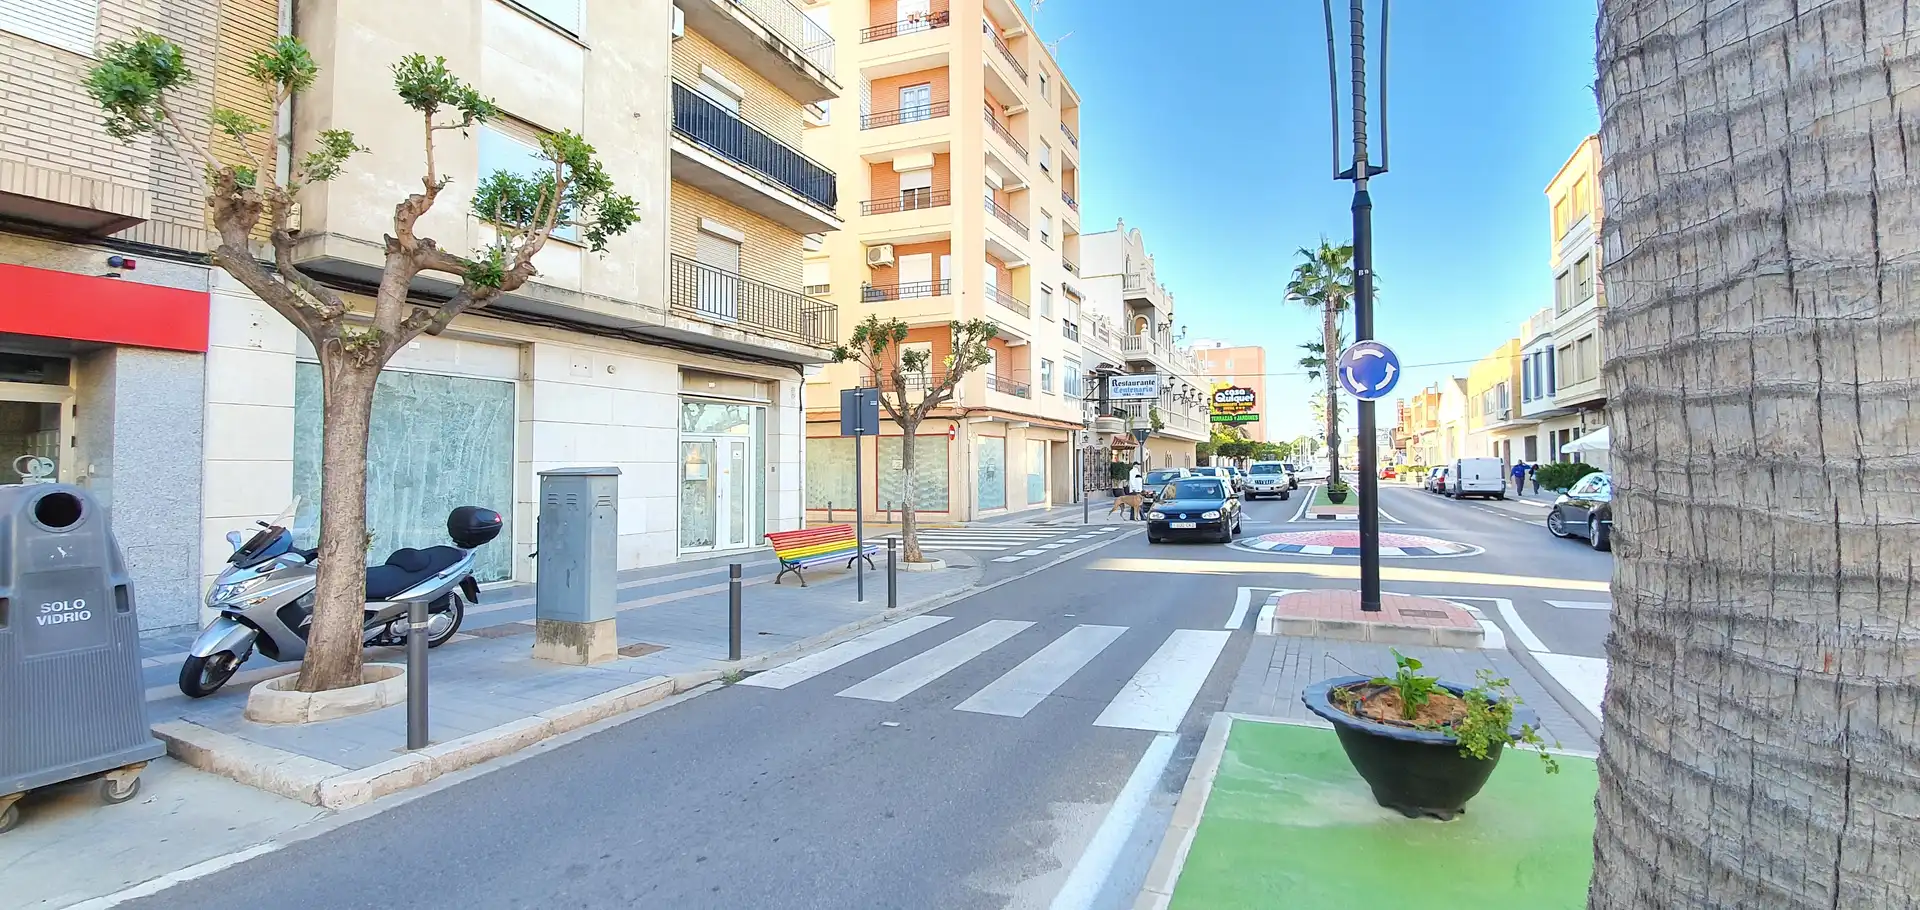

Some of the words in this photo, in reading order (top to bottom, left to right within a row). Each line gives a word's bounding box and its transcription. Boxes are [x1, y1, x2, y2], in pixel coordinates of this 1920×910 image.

[1112, 379, 1155, 387] Restaurante
[1215, 392, 1254, 403] Quiquet
[40, 599, 86, 613] SOLO
[36, 610, 92, 626] VIDRIO
